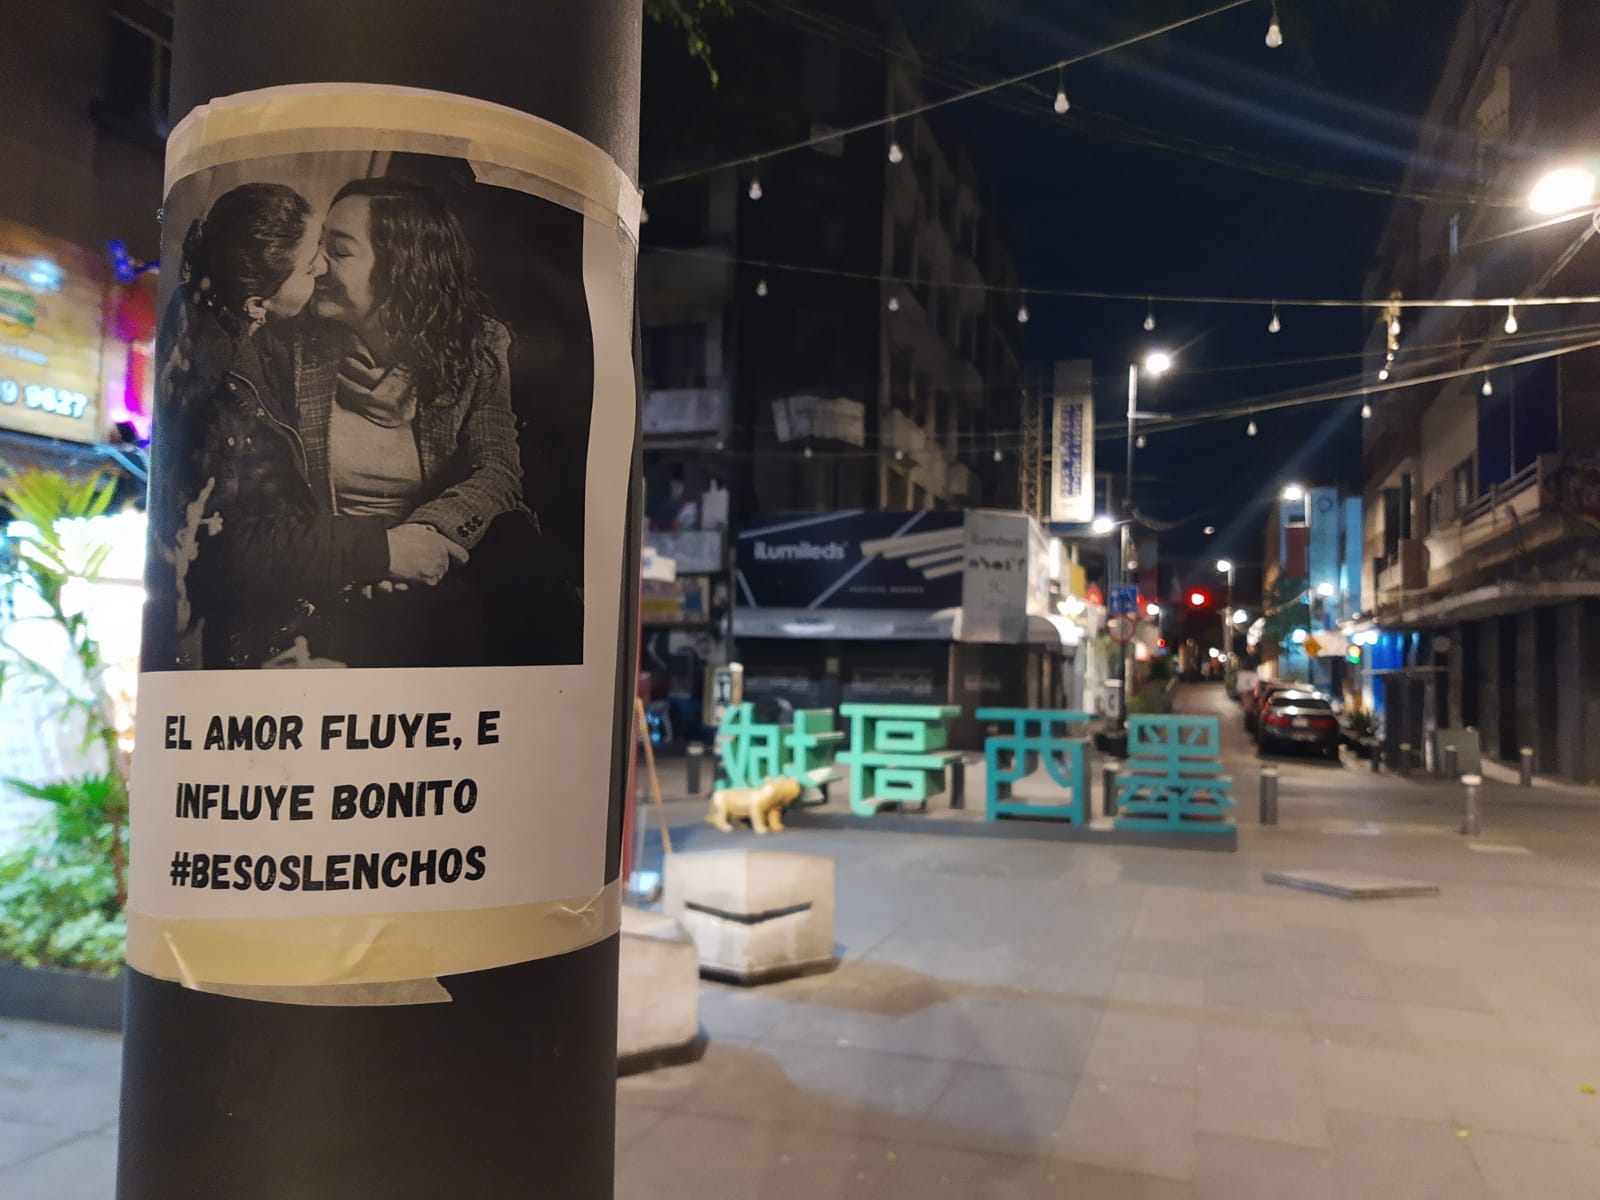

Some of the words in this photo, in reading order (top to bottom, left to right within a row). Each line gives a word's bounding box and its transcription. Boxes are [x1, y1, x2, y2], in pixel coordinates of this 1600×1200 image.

[165, 716, 192, 750] EL
[204, 715, 303, 750] AMOR
[321, 713, 463, 750] FLUYE,
[478, 711, 500, 745] E
[176, 783, 314, 820] INFLUYE
[332, 779, 477, 818] BONITO
[170, 846, 486, 891] #BESOSLENCHOS
